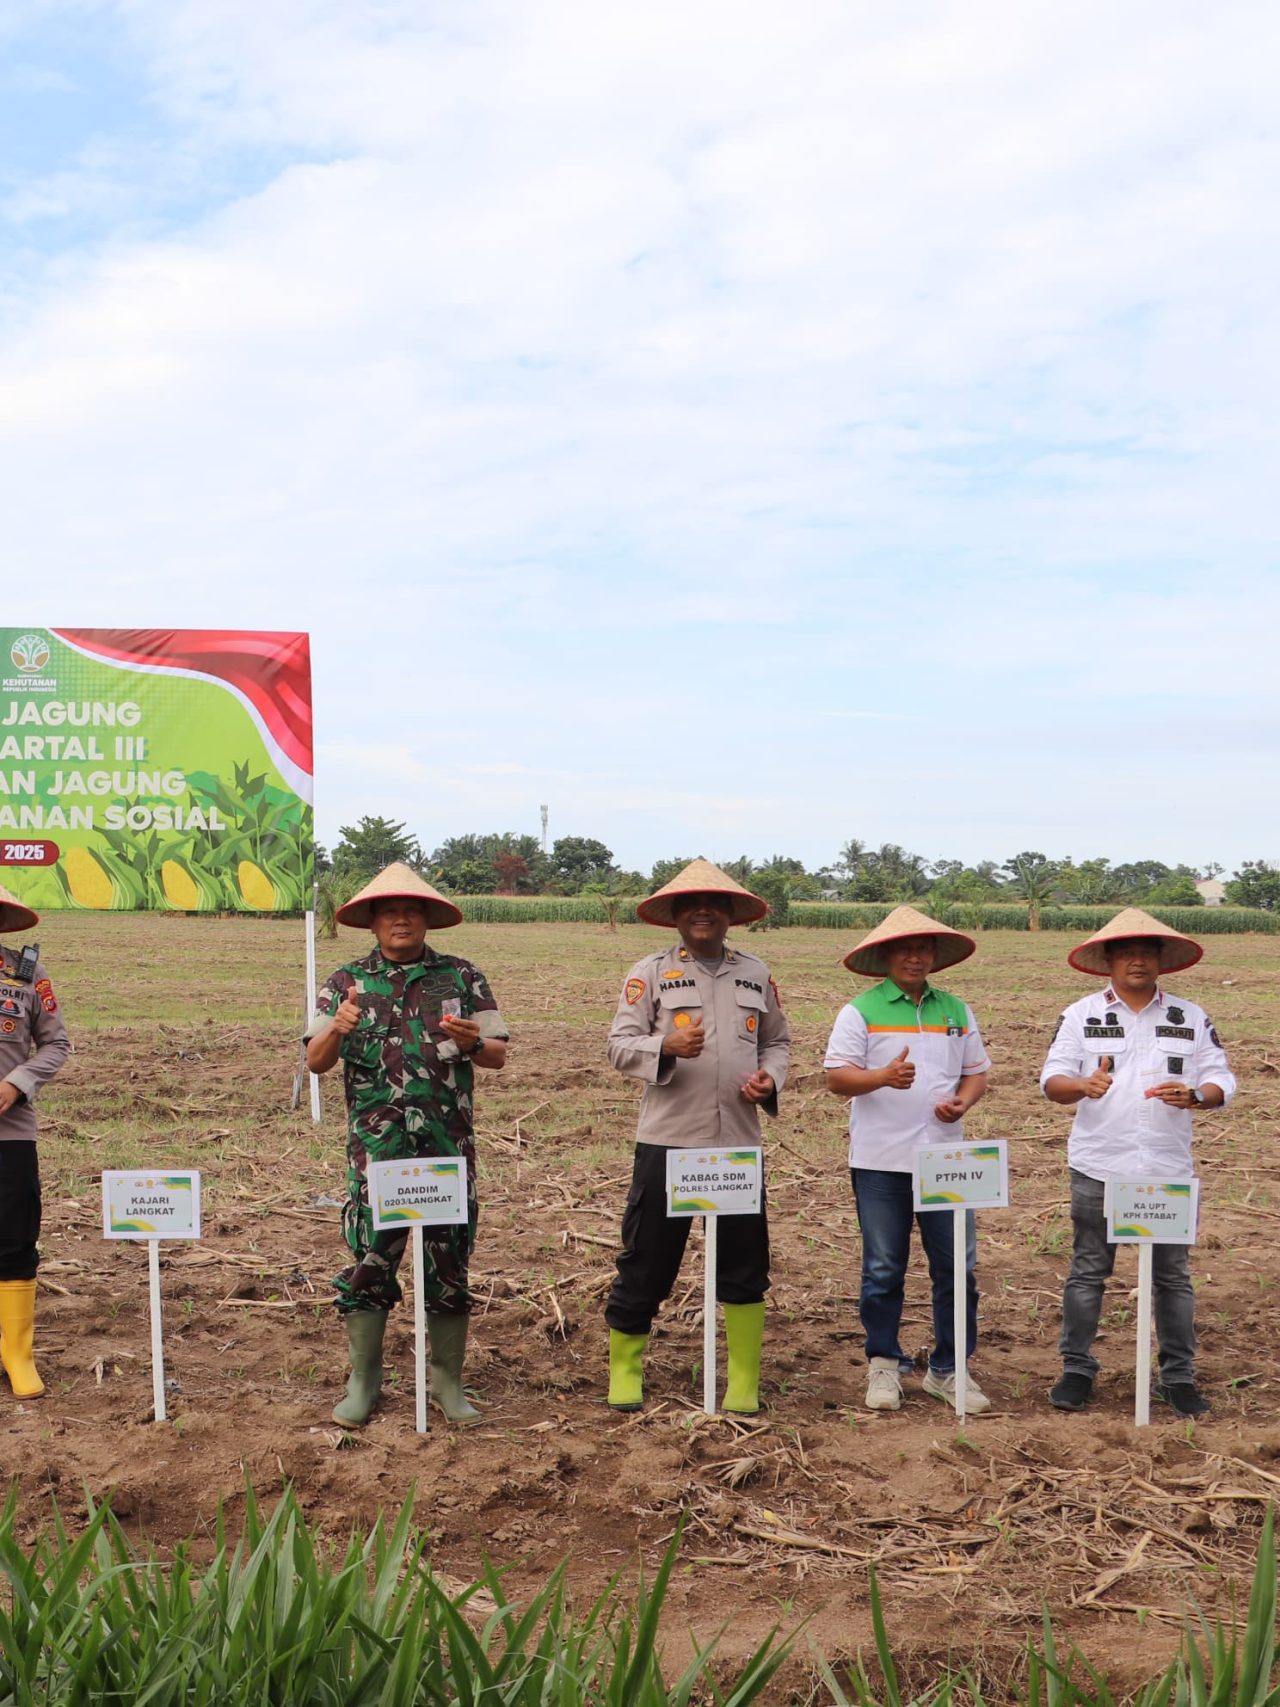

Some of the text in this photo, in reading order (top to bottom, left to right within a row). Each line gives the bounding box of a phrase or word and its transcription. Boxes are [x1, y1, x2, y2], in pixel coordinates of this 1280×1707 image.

[2, 678, 57, 687] KEHUTANAN
[2, 701, 142, 727] JAGUNG
[115, 736, 144, 760] III
[47, 770, 186, 796] JAGUNG
[104, 805, 225, 831] SOSIAL
[4, 844, 44, 861] 2025
[659, 979, 696, 992] HASAN
[1087, 1028, 1122, 1037] TANTA
[1158, 1028, 1193, 1038] POLHUT
[681, 1172, 746, 1182] KABAG SDM
[935, 1170, 983, 1182] PTPN IV
[397, 1185, 438, 1195] DANDIM
[673, 1183, 754, 1193] POLRES LANGKAT
[131, 1196, 169, 1205] KAJARI
[384, 1195, 453, 1207] 0203/LANGKAT
[1134, 1202, 1146, 1210] KA
[126, 1207, 175, 1216] LANGKAT
[1143, 1212, 1177, 1220] STABAT
